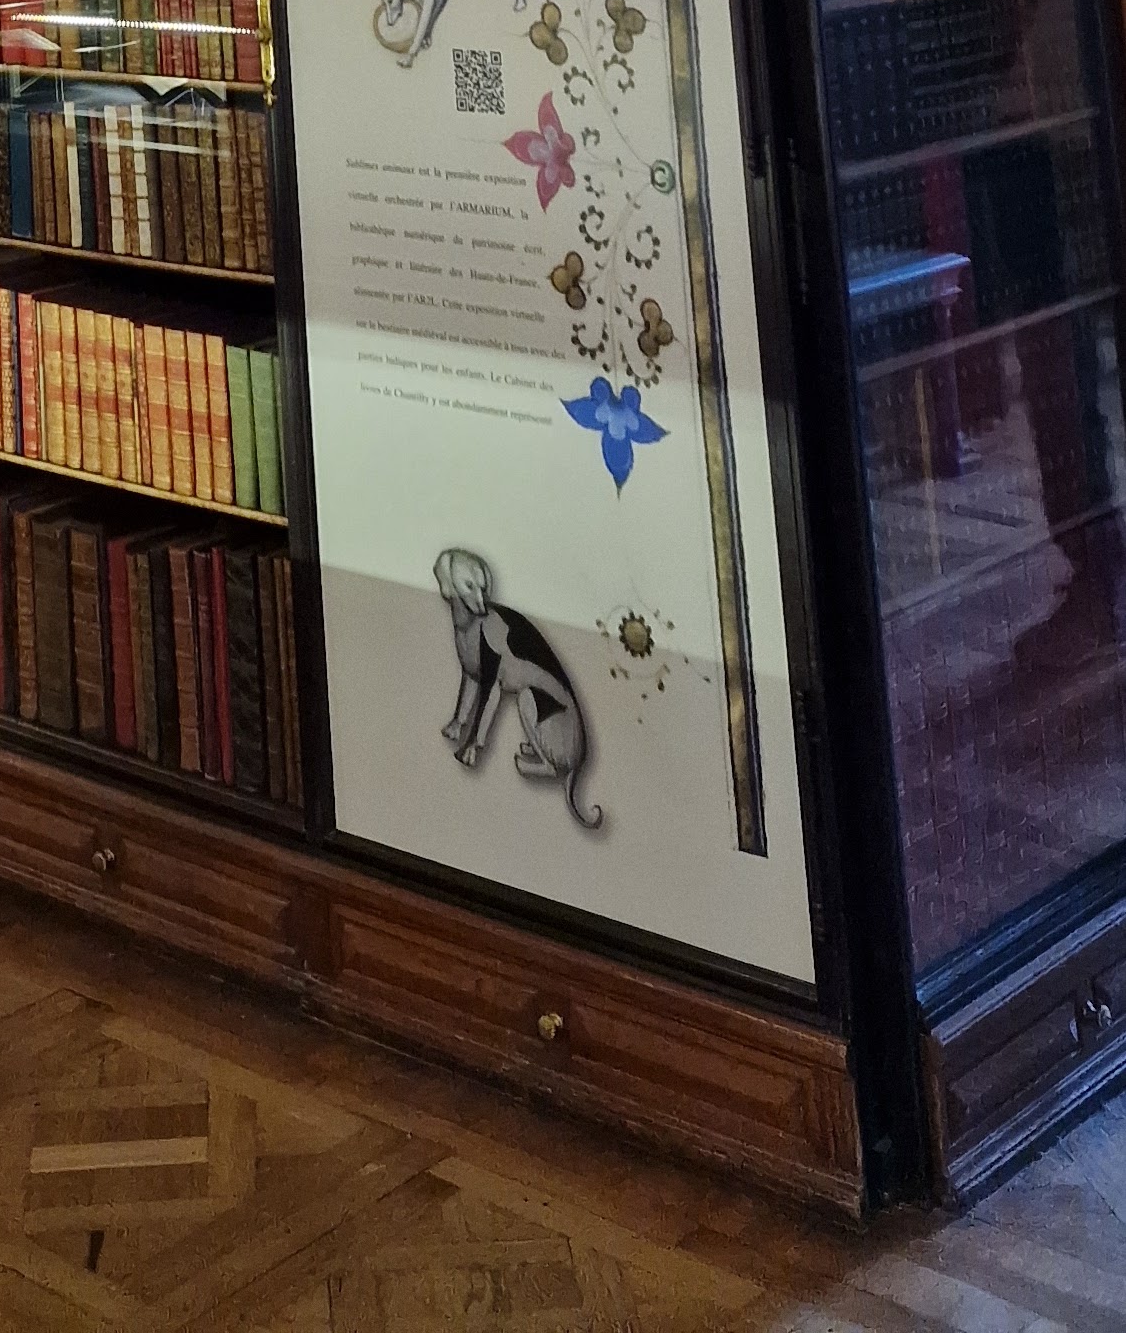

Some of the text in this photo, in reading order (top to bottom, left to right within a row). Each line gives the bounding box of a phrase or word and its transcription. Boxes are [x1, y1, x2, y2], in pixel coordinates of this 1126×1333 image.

[434, 166, 441, 178] la
[520, 208, 529, 220] la
[490, 371, 502, 383] Le
